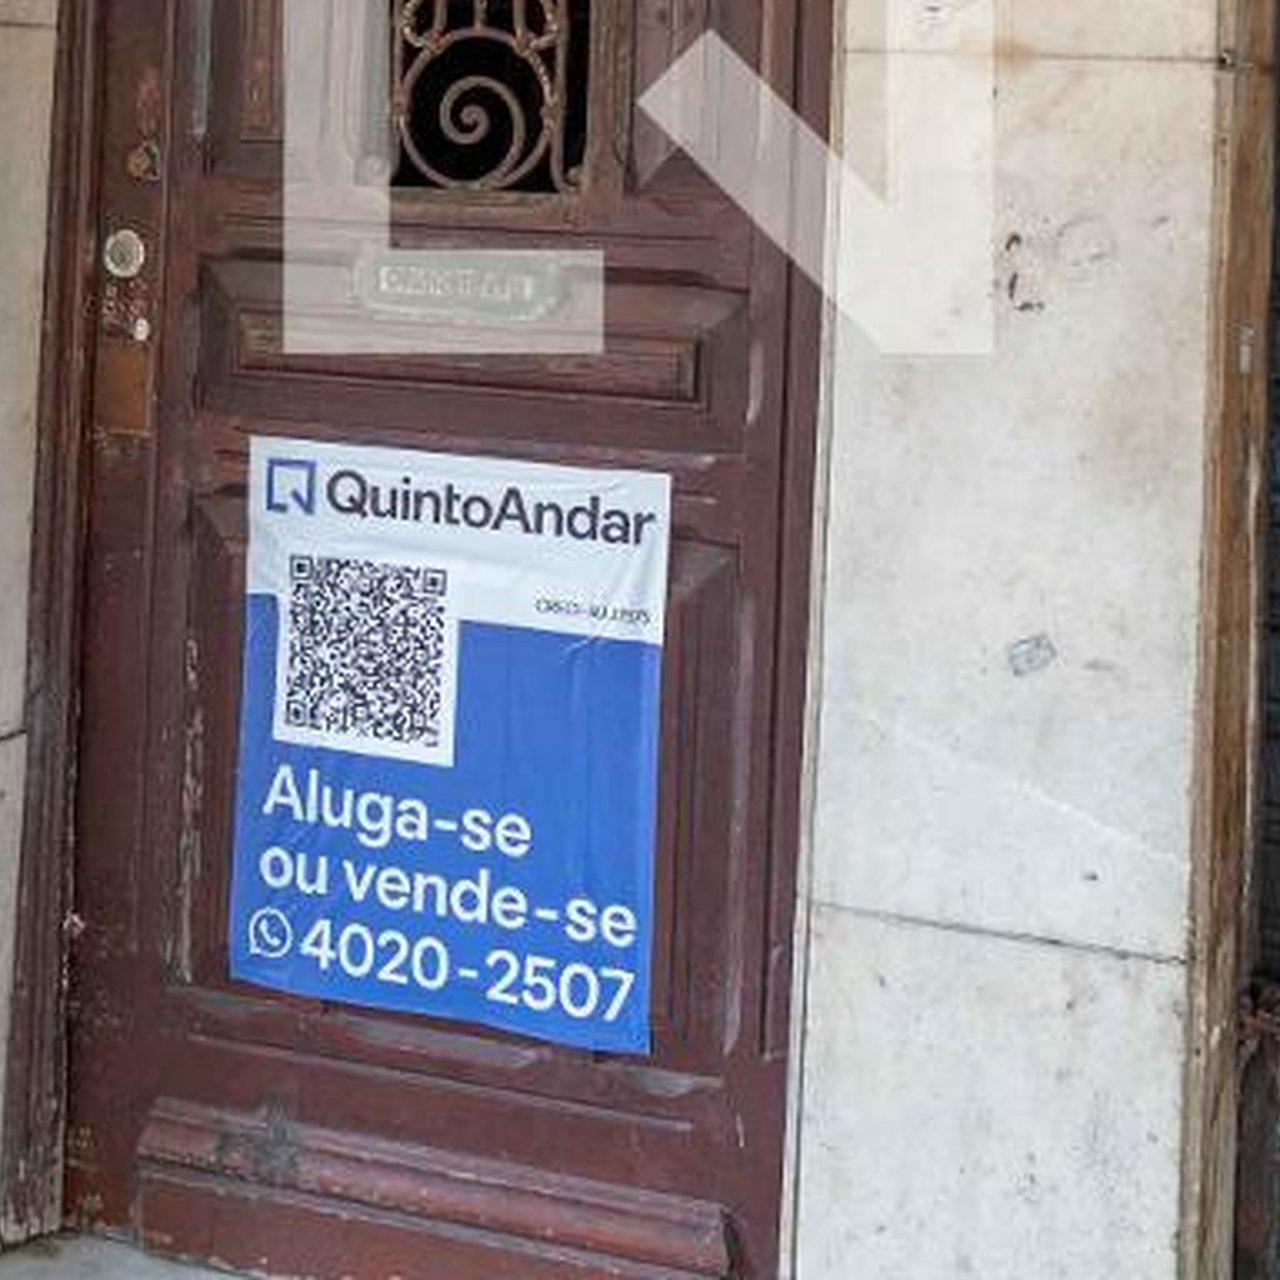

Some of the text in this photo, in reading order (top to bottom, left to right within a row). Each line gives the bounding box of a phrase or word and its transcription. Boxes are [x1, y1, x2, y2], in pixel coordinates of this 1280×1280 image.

[325, 468, 657, 547] QuintoAndar
[262, 763, 533, 857] Aluga-se
[258, 844, 638, 949] ou vende-se
[299, 918, 636, 1023] 4020-2507
